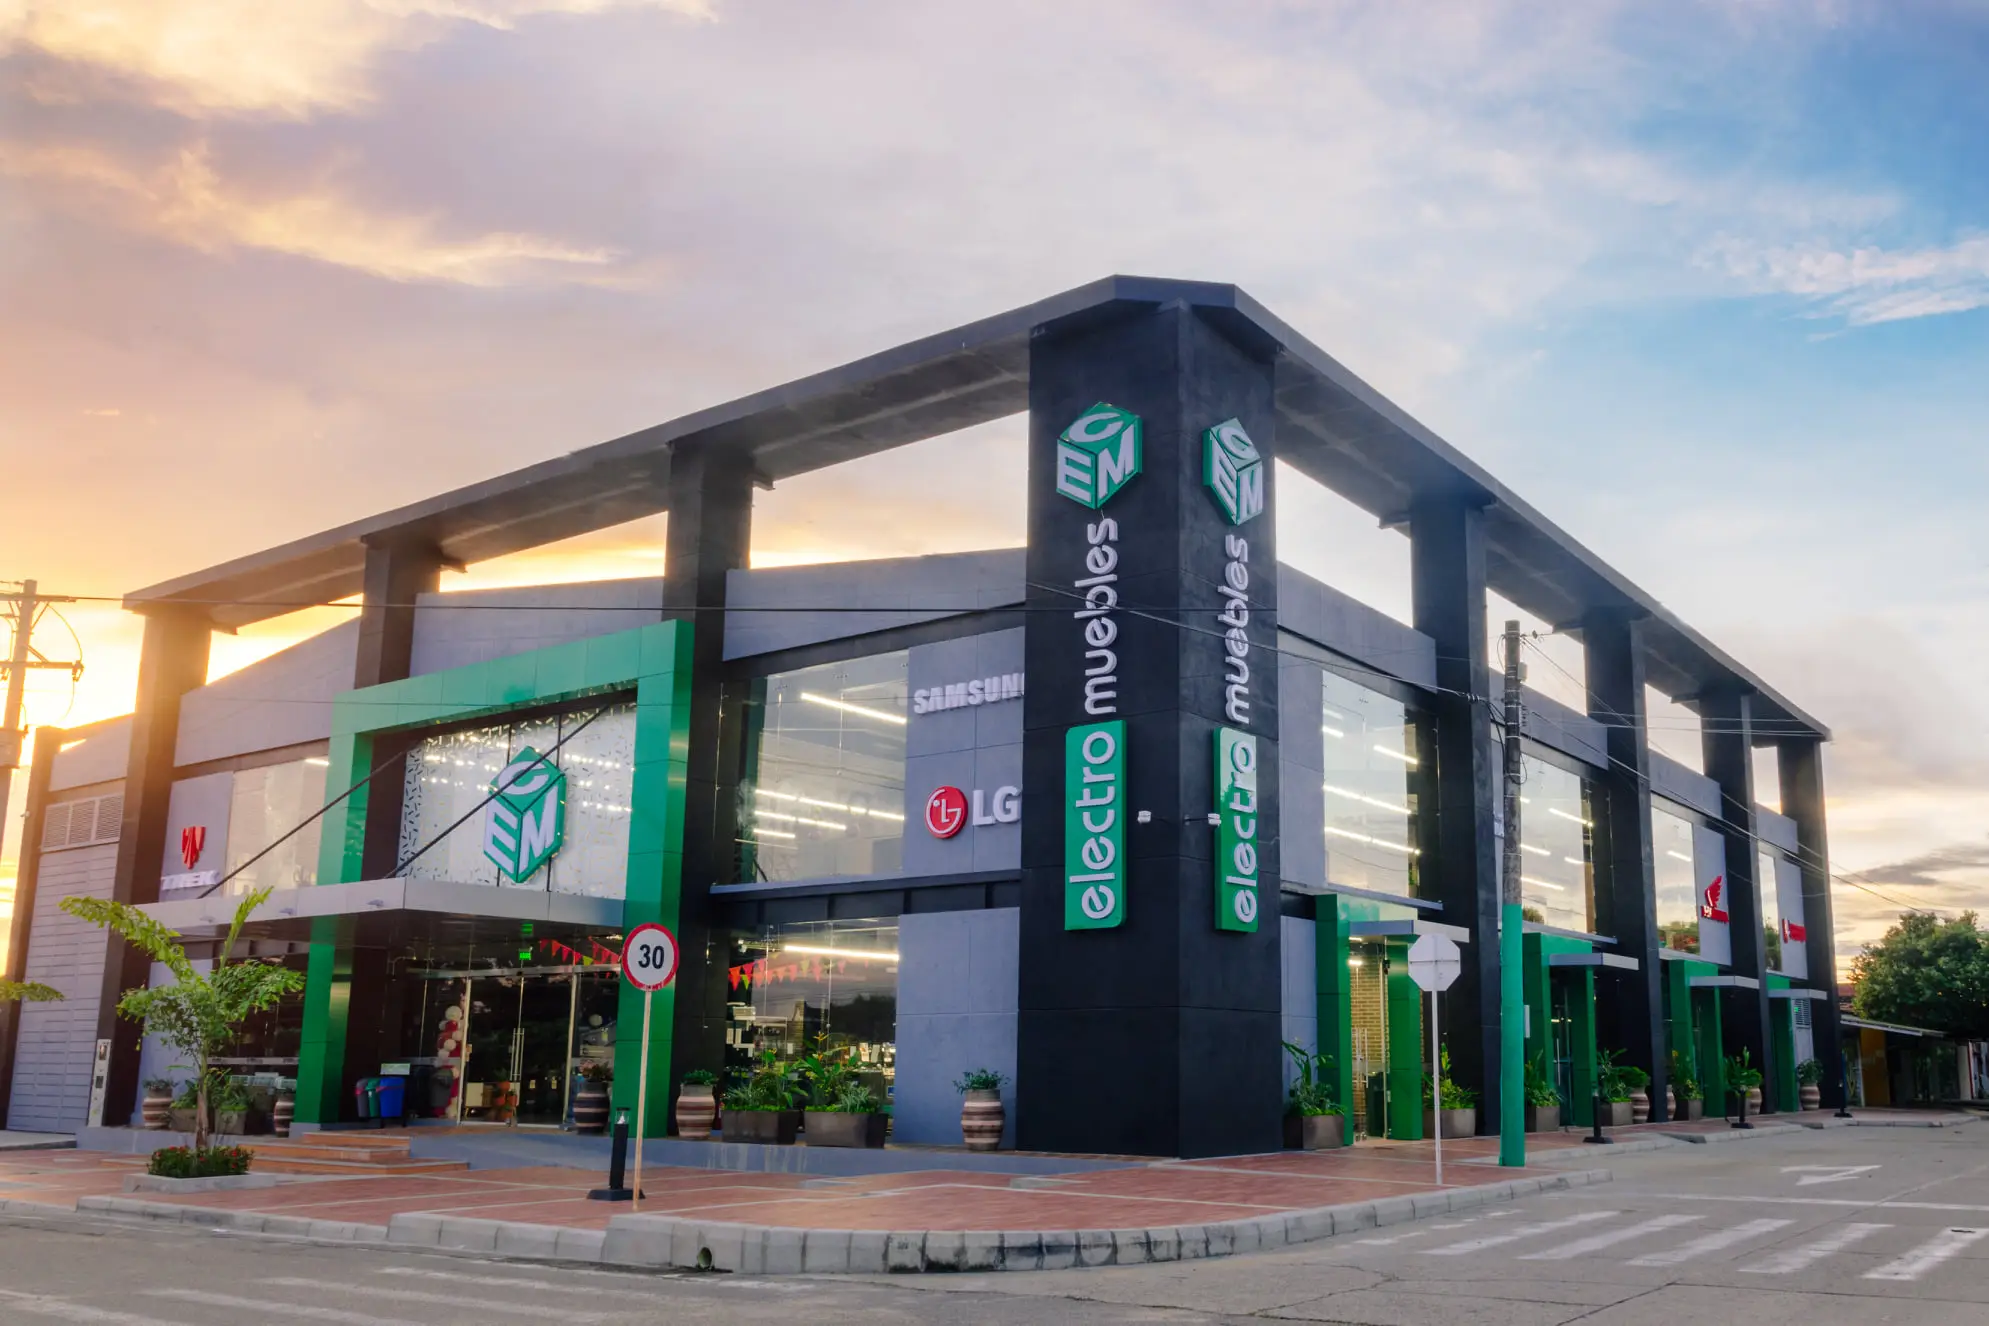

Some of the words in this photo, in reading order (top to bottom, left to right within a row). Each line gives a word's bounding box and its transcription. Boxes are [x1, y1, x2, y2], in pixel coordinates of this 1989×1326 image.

[913, 671, 1025, 715] SAMSUN
[1074, 517, 1118, 716] muebles
[1217, 534, 1249, 725] muebles
[972, 785, 1023, 827] LG
[1068, 730, 1117, 920] electro
[1226, 740, 1257, 924] electro
[637, 943, 665, 970] 30
